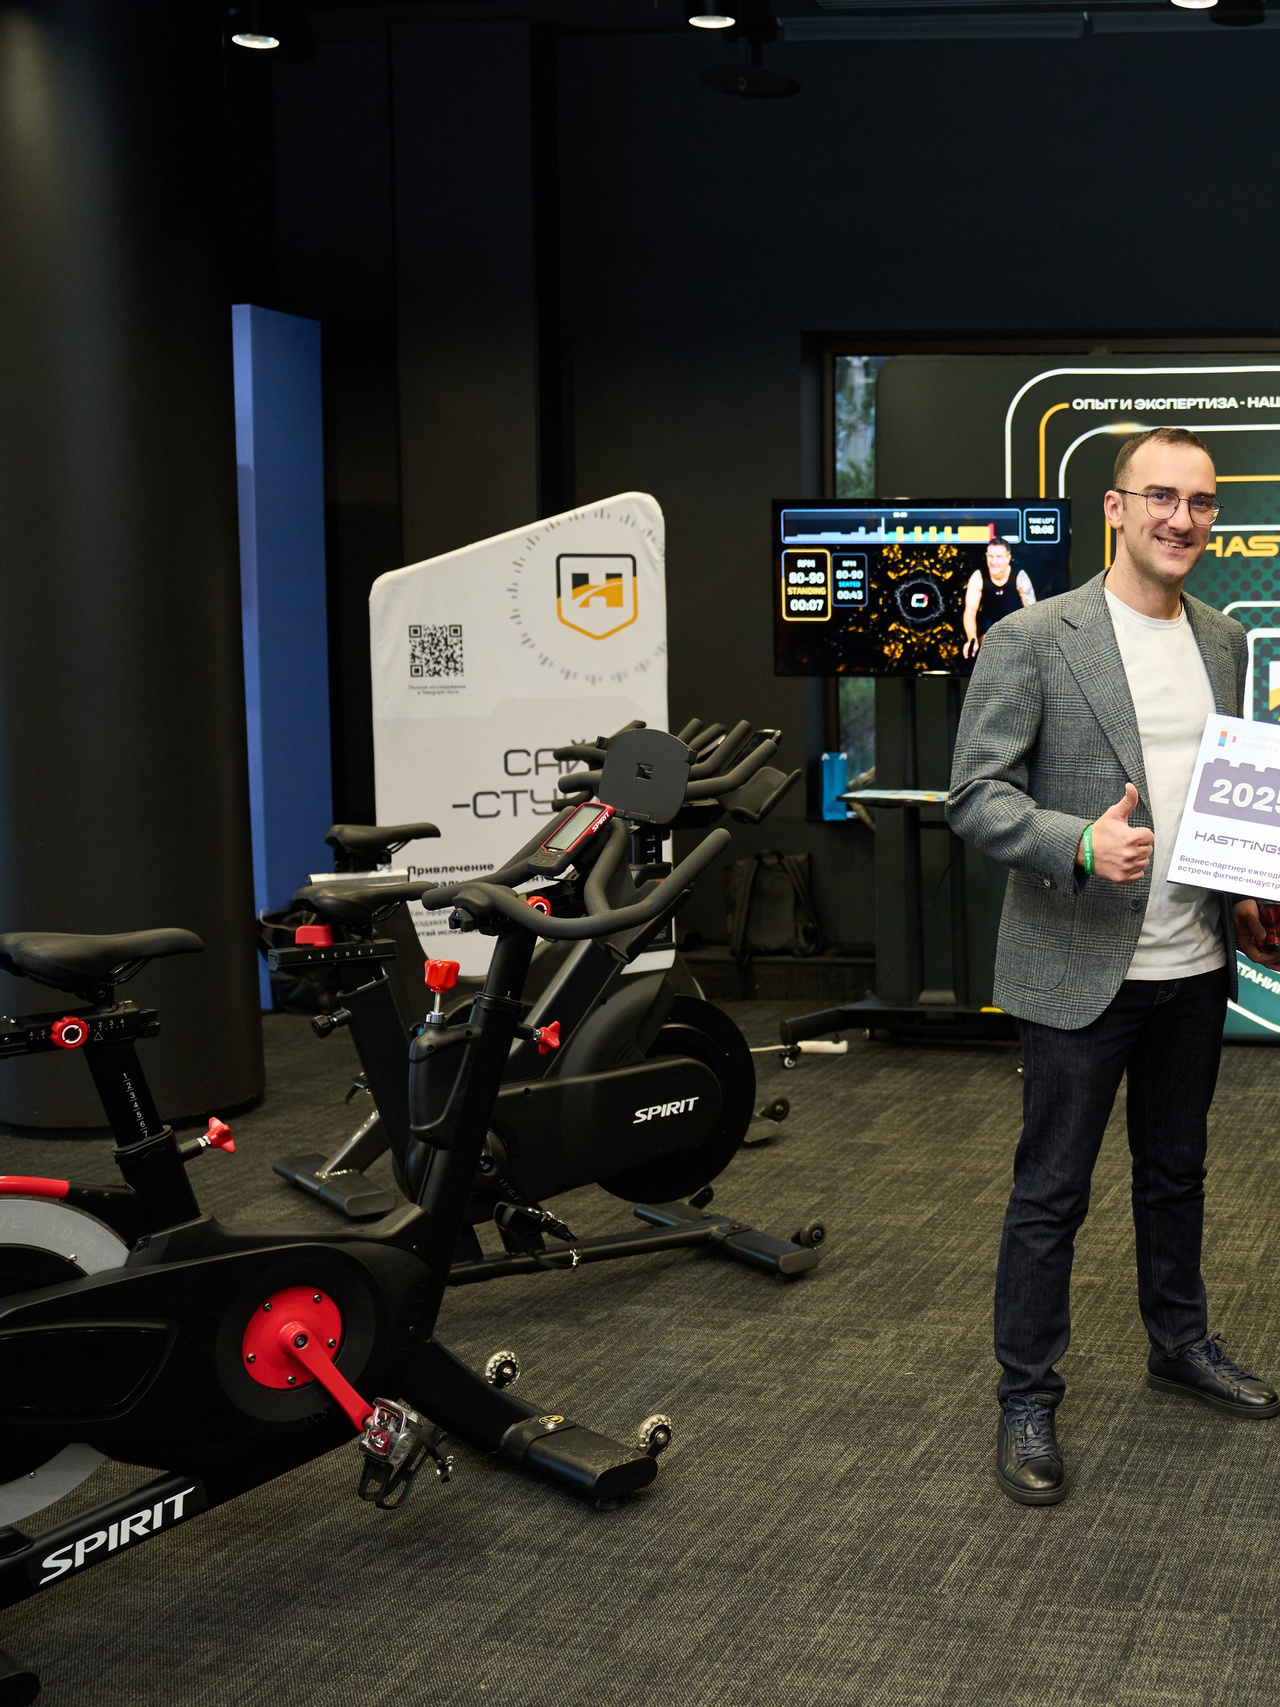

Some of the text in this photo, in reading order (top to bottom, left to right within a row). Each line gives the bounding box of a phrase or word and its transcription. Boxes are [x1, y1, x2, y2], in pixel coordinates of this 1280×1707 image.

[1072, 398, 1117, 410] ОПЫТ
[1120, 398, 1132, 409] И
[1134, 397, 1238, 410] ЭКСПЕРТИЗА
[797, 559, 816, 568] RPM
[788, 572, 825, 584] 80-90
[836, 570, 864, 579] 80-90
[787, 587, 827, 595] STANDING
[790, 599, 824, 611] 00:07
[592, 811, 609, 832] SPIRIT
[1179, 854, 1247, 873] Бизнес-партнер
[407, 863, 494, 877] Привлечение
[1177, 865, 1212, 877] встречи
[632, 1096, 699, 1124] SPIRIT
[39, 1486, 195, 1586] SPIRIT
